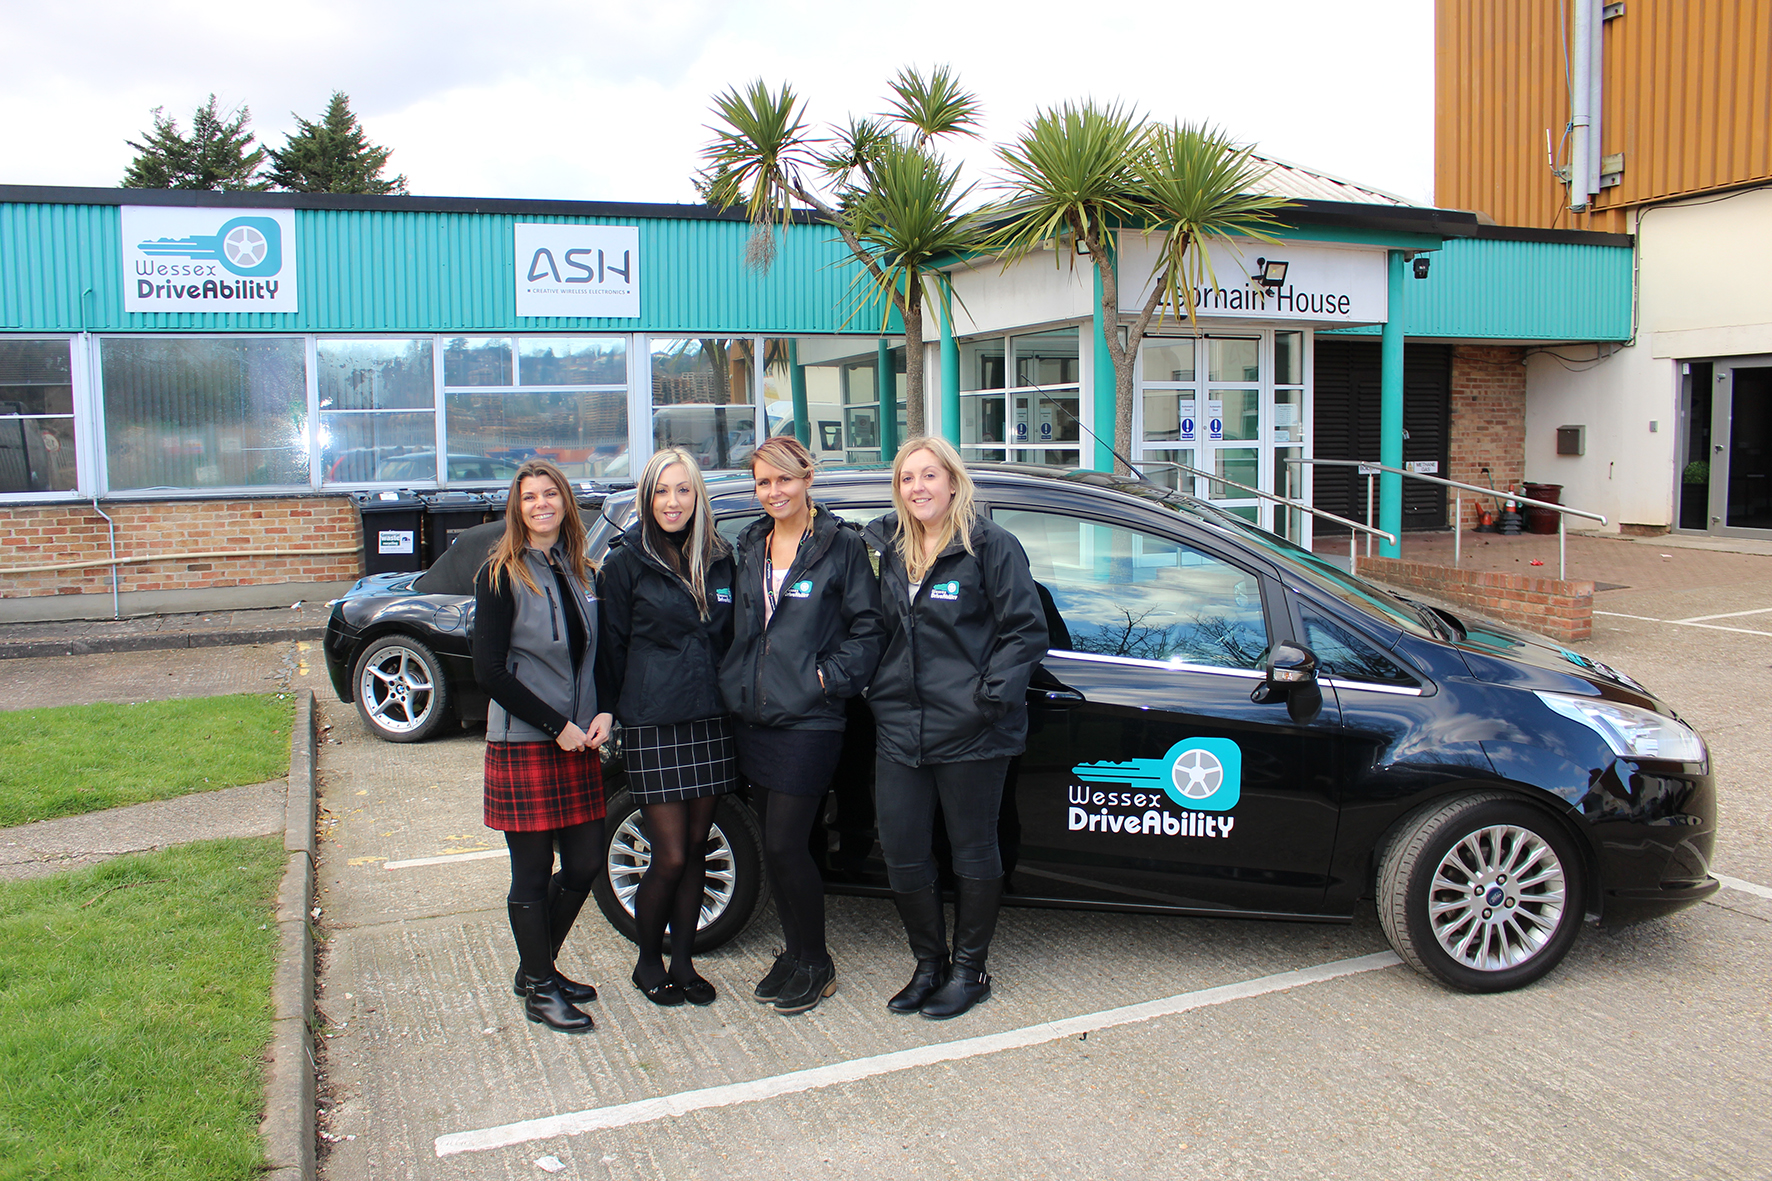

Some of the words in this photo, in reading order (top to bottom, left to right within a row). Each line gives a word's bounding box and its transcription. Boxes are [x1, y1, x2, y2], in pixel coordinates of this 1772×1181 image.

[135, 259, 217, 276] Wessex
[527, 247, 631, 284] ASH
[1277, 284, 1351, 314] House
[1068, 785, 1161, 808] Wessex
